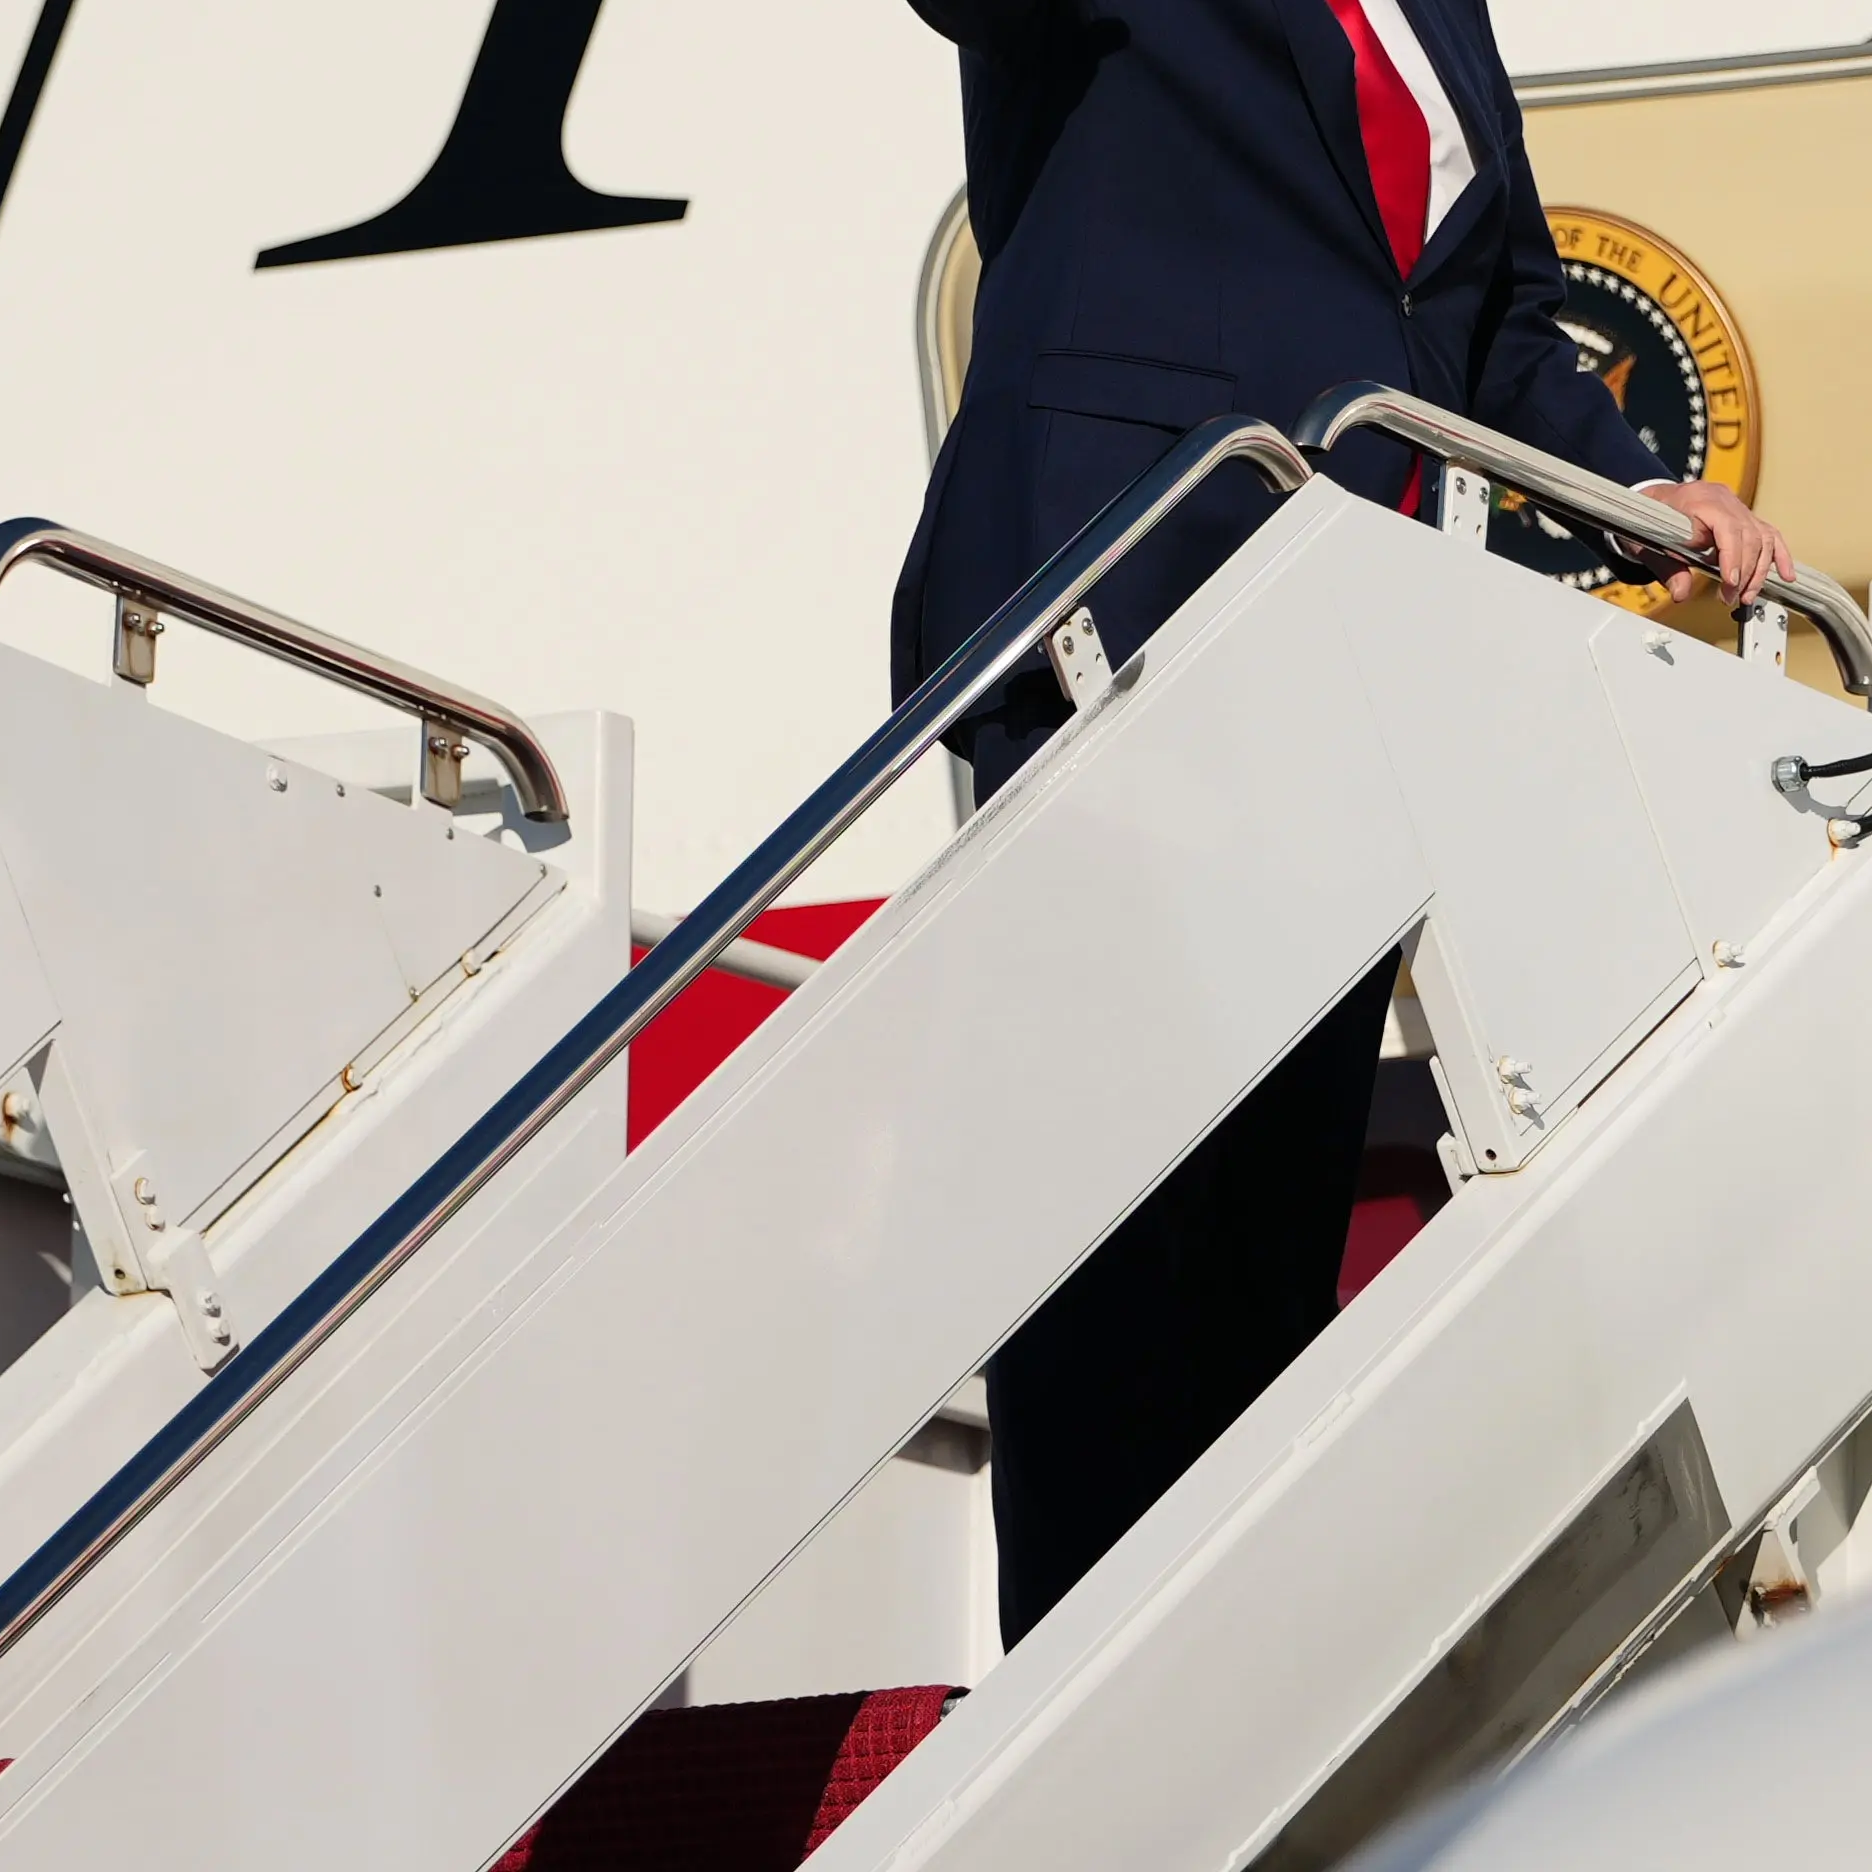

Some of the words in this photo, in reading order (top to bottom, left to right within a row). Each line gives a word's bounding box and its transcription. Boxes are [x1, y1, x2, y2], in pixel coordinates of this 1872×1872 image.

[1553, 228, 1583, 250] OF
[1598, 234, 1642, 273] THE
[1658, 271, 1741, 450] UNITED
